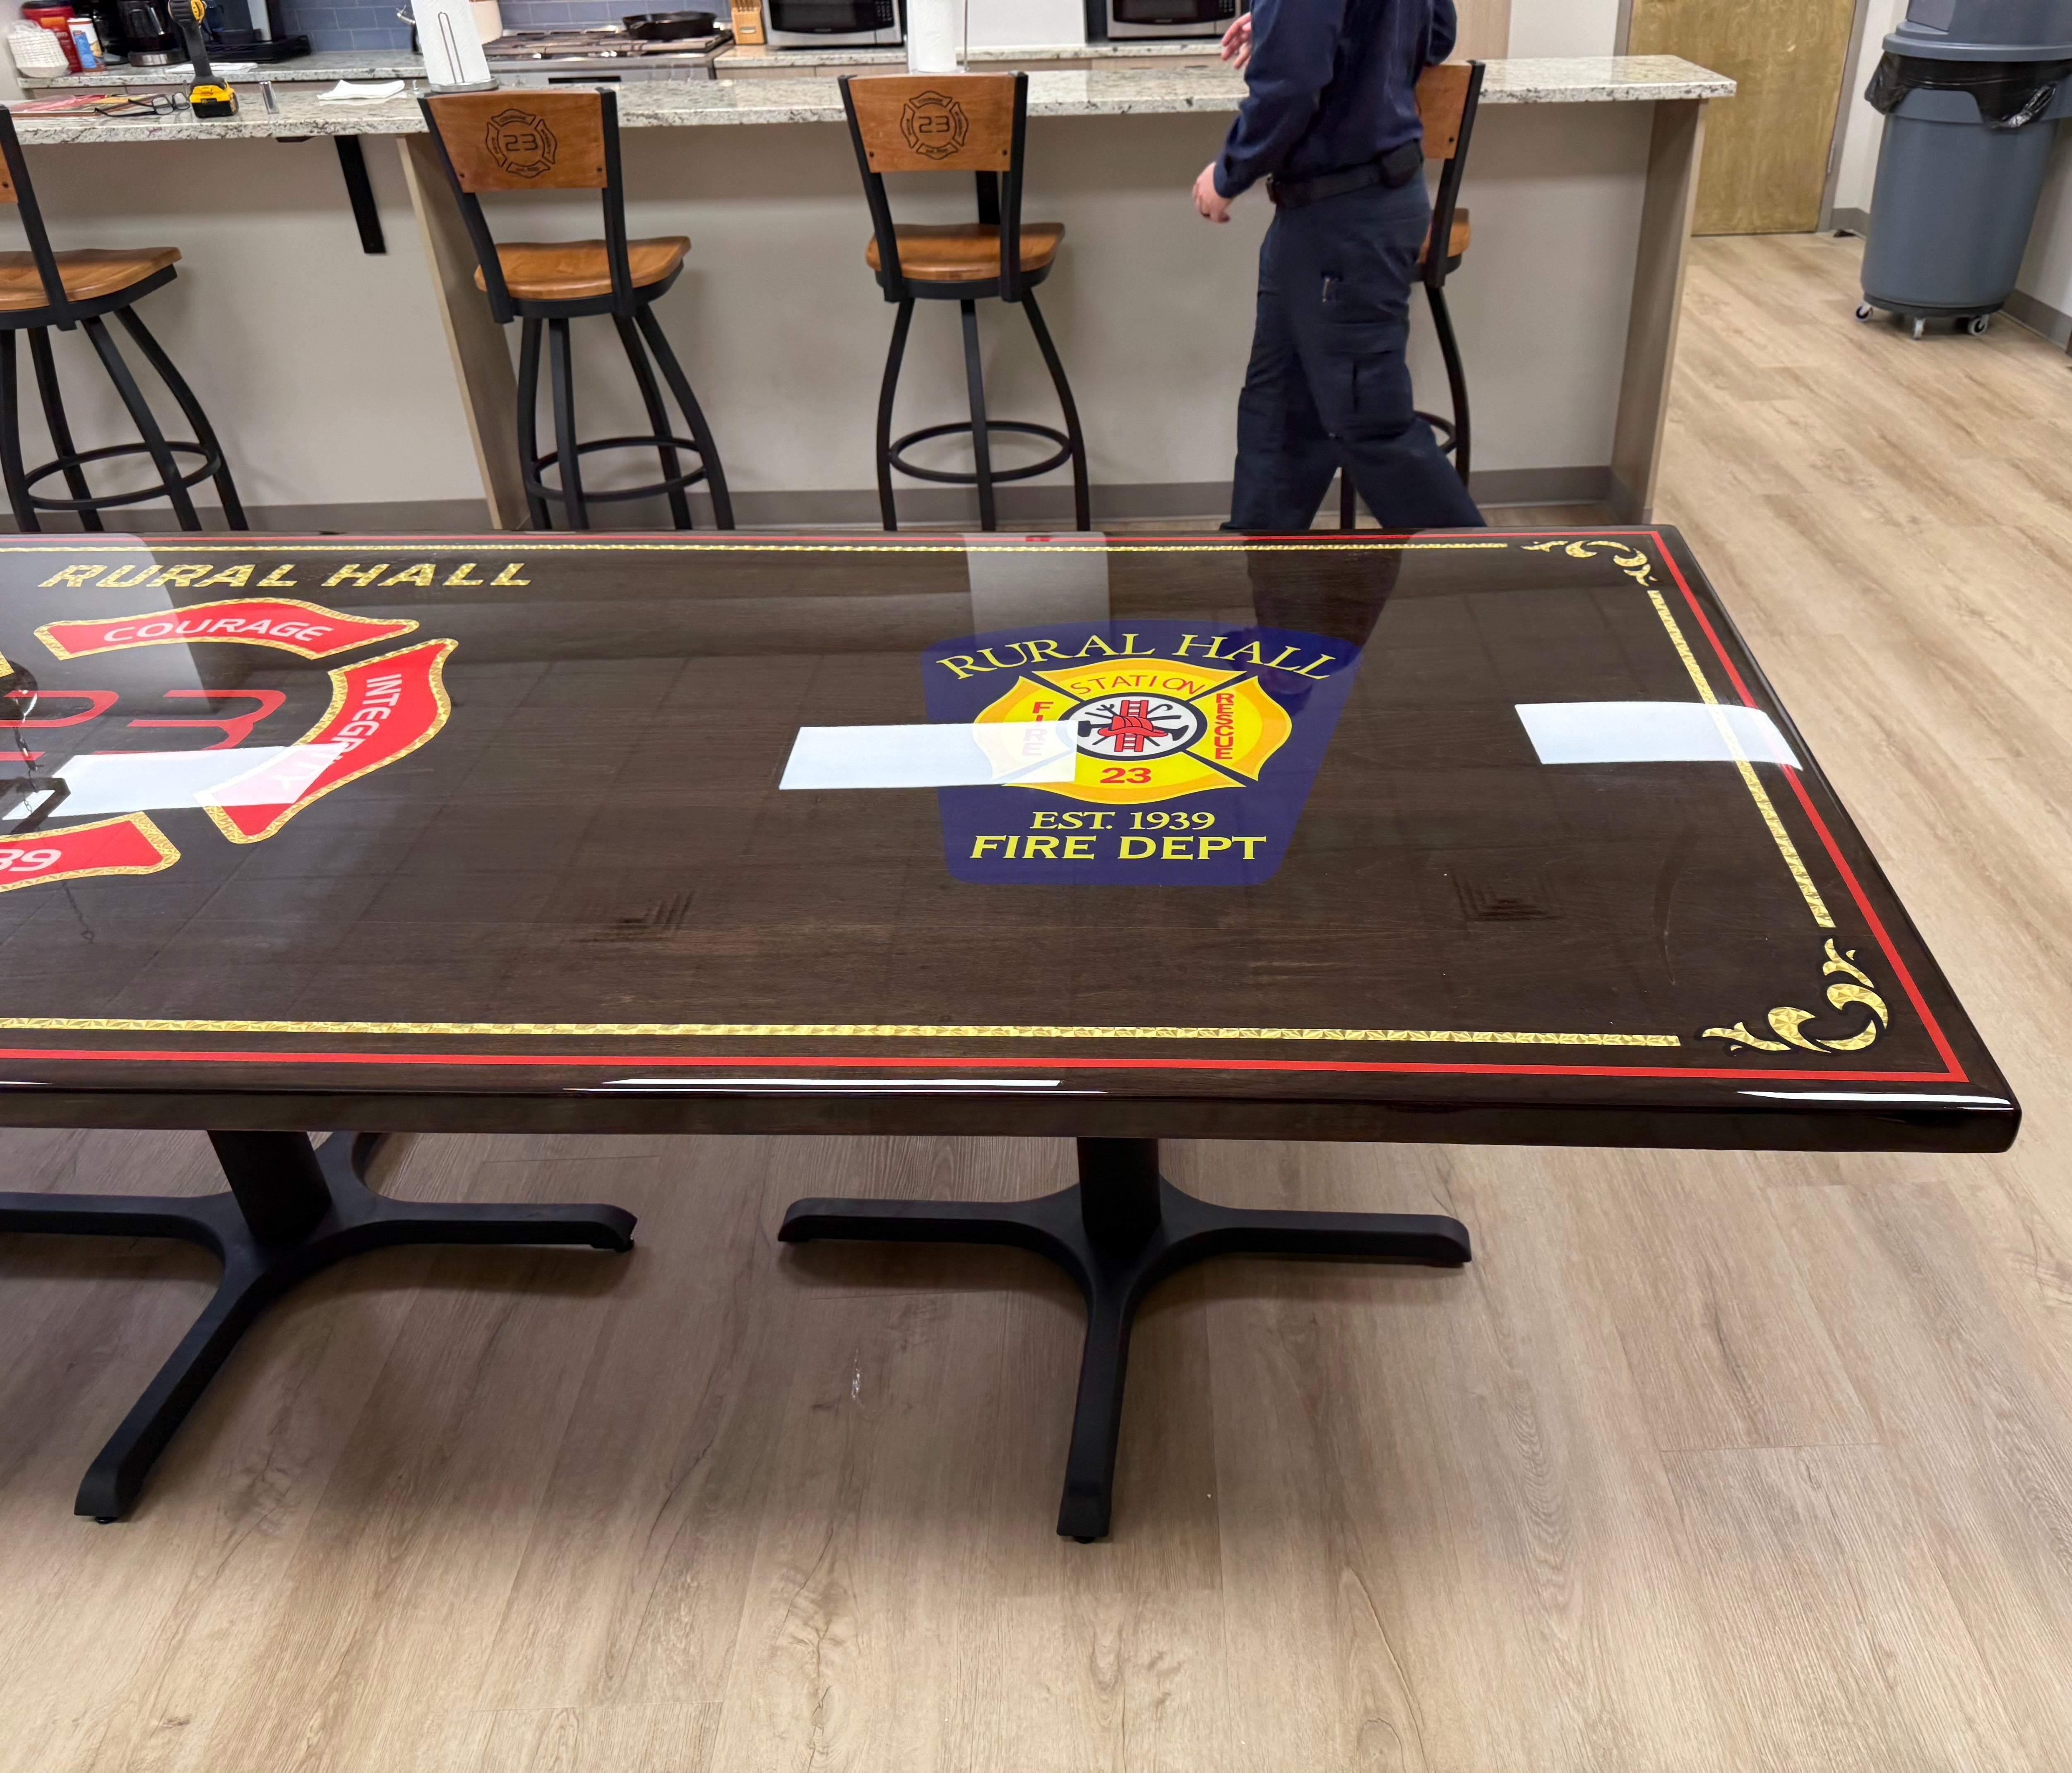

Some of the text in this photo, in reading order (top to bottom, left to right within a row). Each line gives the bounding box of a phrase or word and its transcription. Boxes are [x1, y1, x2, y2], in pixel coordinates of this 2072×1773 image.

[918, 116, 950, 133] 23
[503, 133, 538, 152] 23
[38, 563, 531, 587] RURAL HALL
[104, 618, 333, 642] COURAGE
[936, 633, 1336, 680] RURAL HALL
[1070, 675, 1206, 695] STATION
[0, 690, 286, 761] 23
[1022, 702, 1054, 757] FIRE
[1214, 693, 1236, 760] RESCUE
[1099, 767, 1152, 784] 23
[1029, 811, 1215, 830] EST. 1939
[969, 835, 1267, 860] FIRE DEPT
